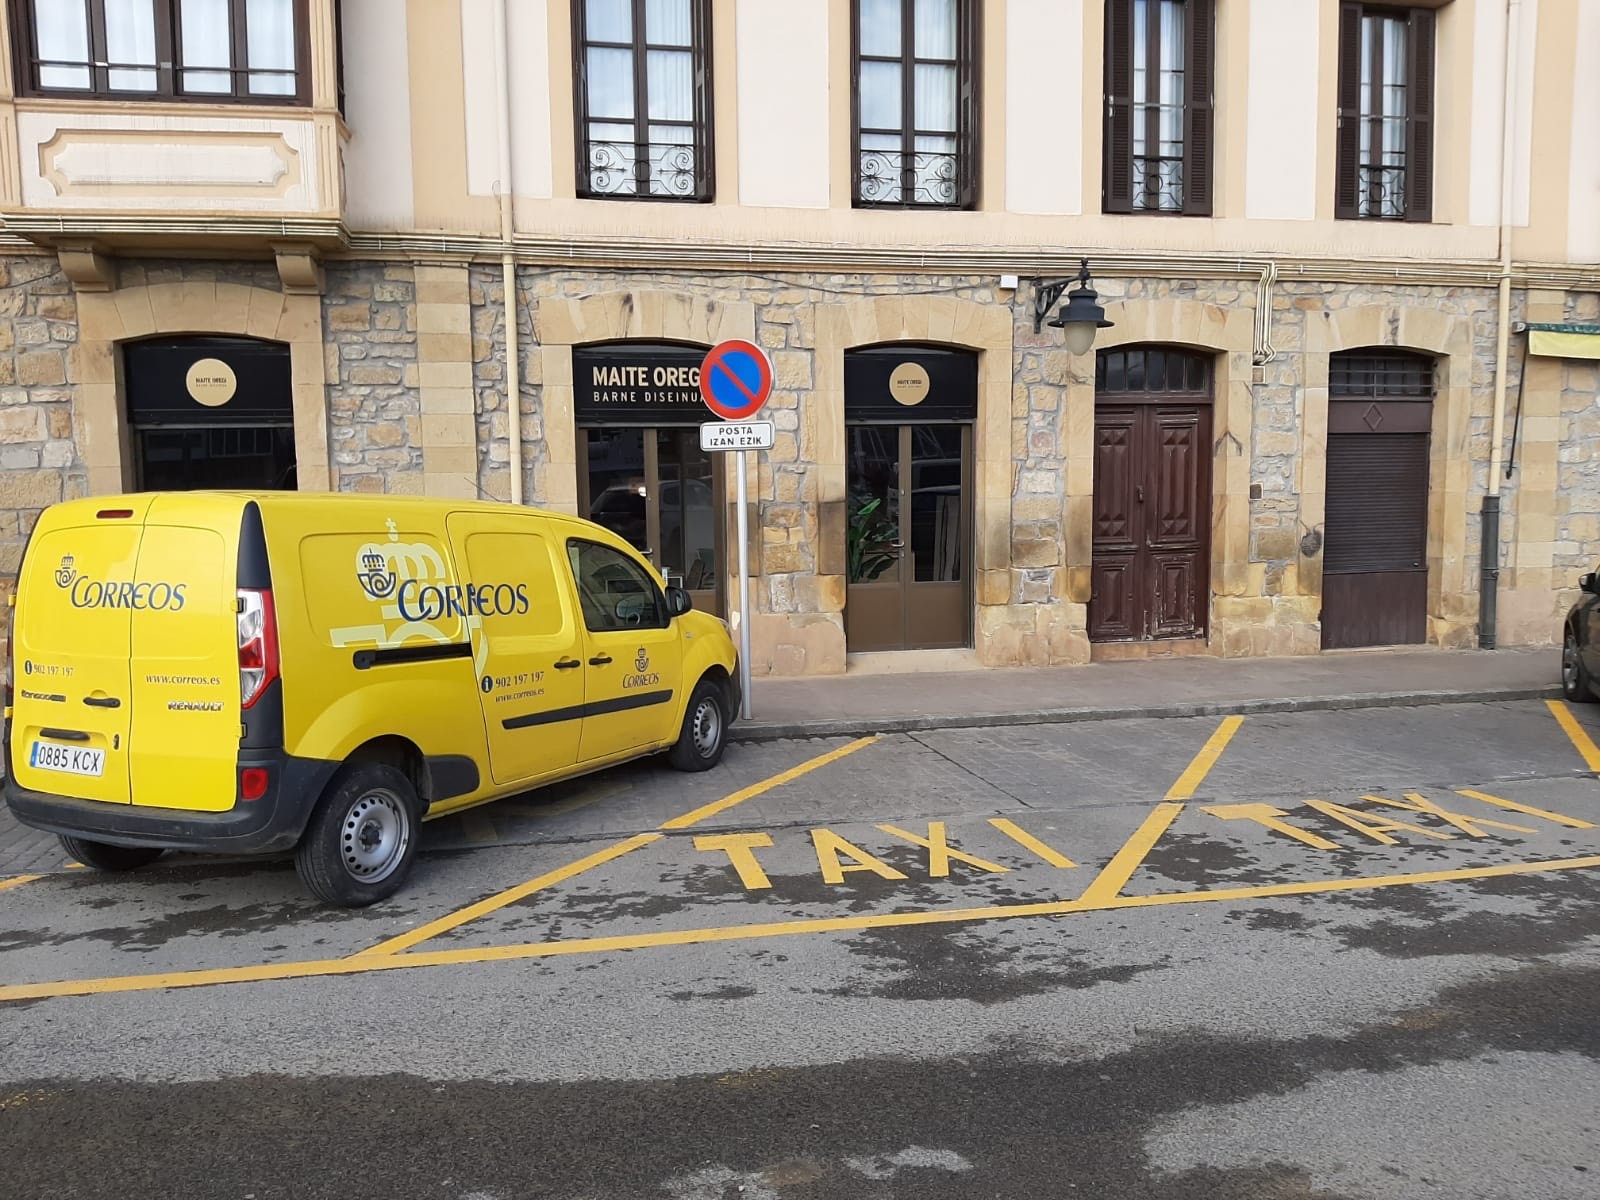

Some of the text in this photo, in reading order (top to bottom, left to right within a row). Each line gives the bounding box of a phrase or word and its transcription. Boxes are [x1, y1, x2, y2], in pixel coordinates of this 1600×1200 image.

[593, 366, 700, 387] MAITE OREG
[594, 391, 637, 402] BARNE
[719, 426, 753, 435] POSTA
[710, 436, 762, 446] IZAN EZIK
[71, 575, 187, 611] CORREOS
[398, 578, 529, 622] CORREOS
[146, 675, 221, 685] www.correos.es
[496, 671, 545, 688] 902 197 197
[623, 673, 659, 688] CORREOS
[168, 701, 224, 711] RENAULT
[38, 746, 101, 772] 0885 KCX
[1199, 789, 1599, 849] TAXI
[693, 818, 1078, 890] TAXI
